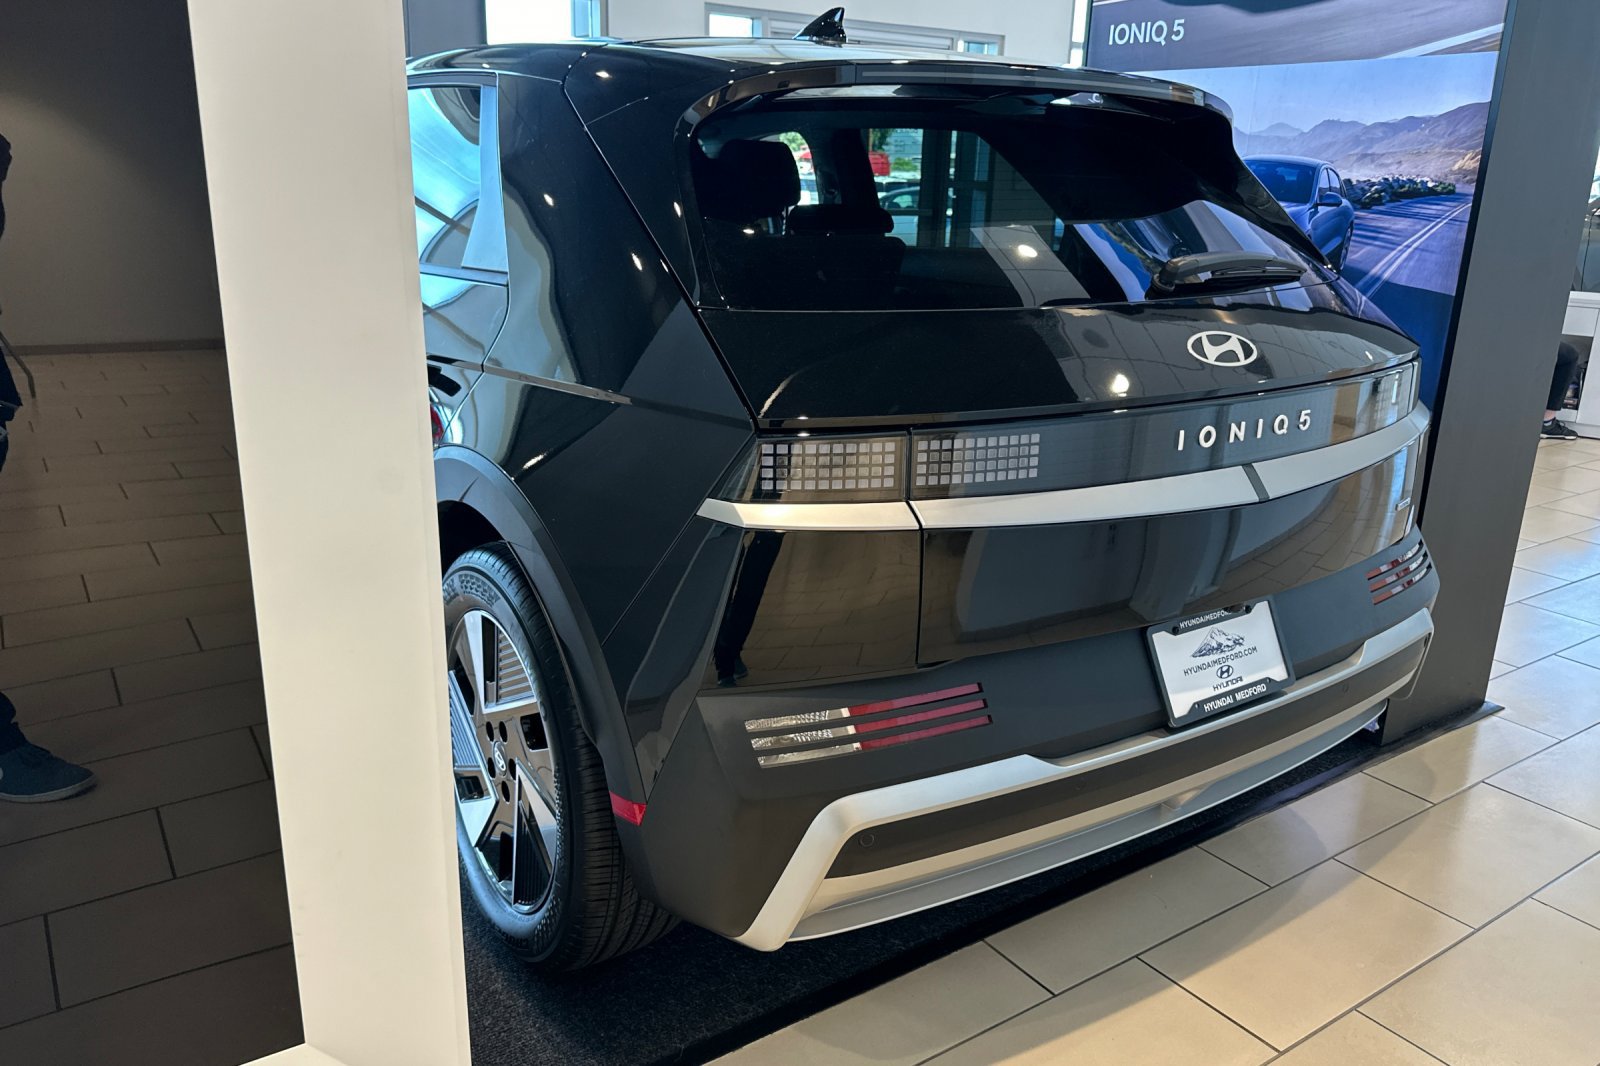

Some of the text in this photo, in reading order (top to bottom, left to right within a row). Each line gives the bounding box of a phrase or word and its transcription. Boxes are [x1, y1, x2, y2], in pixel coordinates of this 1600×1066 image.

[1108, 19, 1185, 46] IONIQ 5
[1183, 646, 1258, 676] HYUNDAIMEDFORD.COM
[1203, 683, 1267, 712] HYUNDAI MEDFORD
[1213, 676, 1244, 691] HYUNDAI
